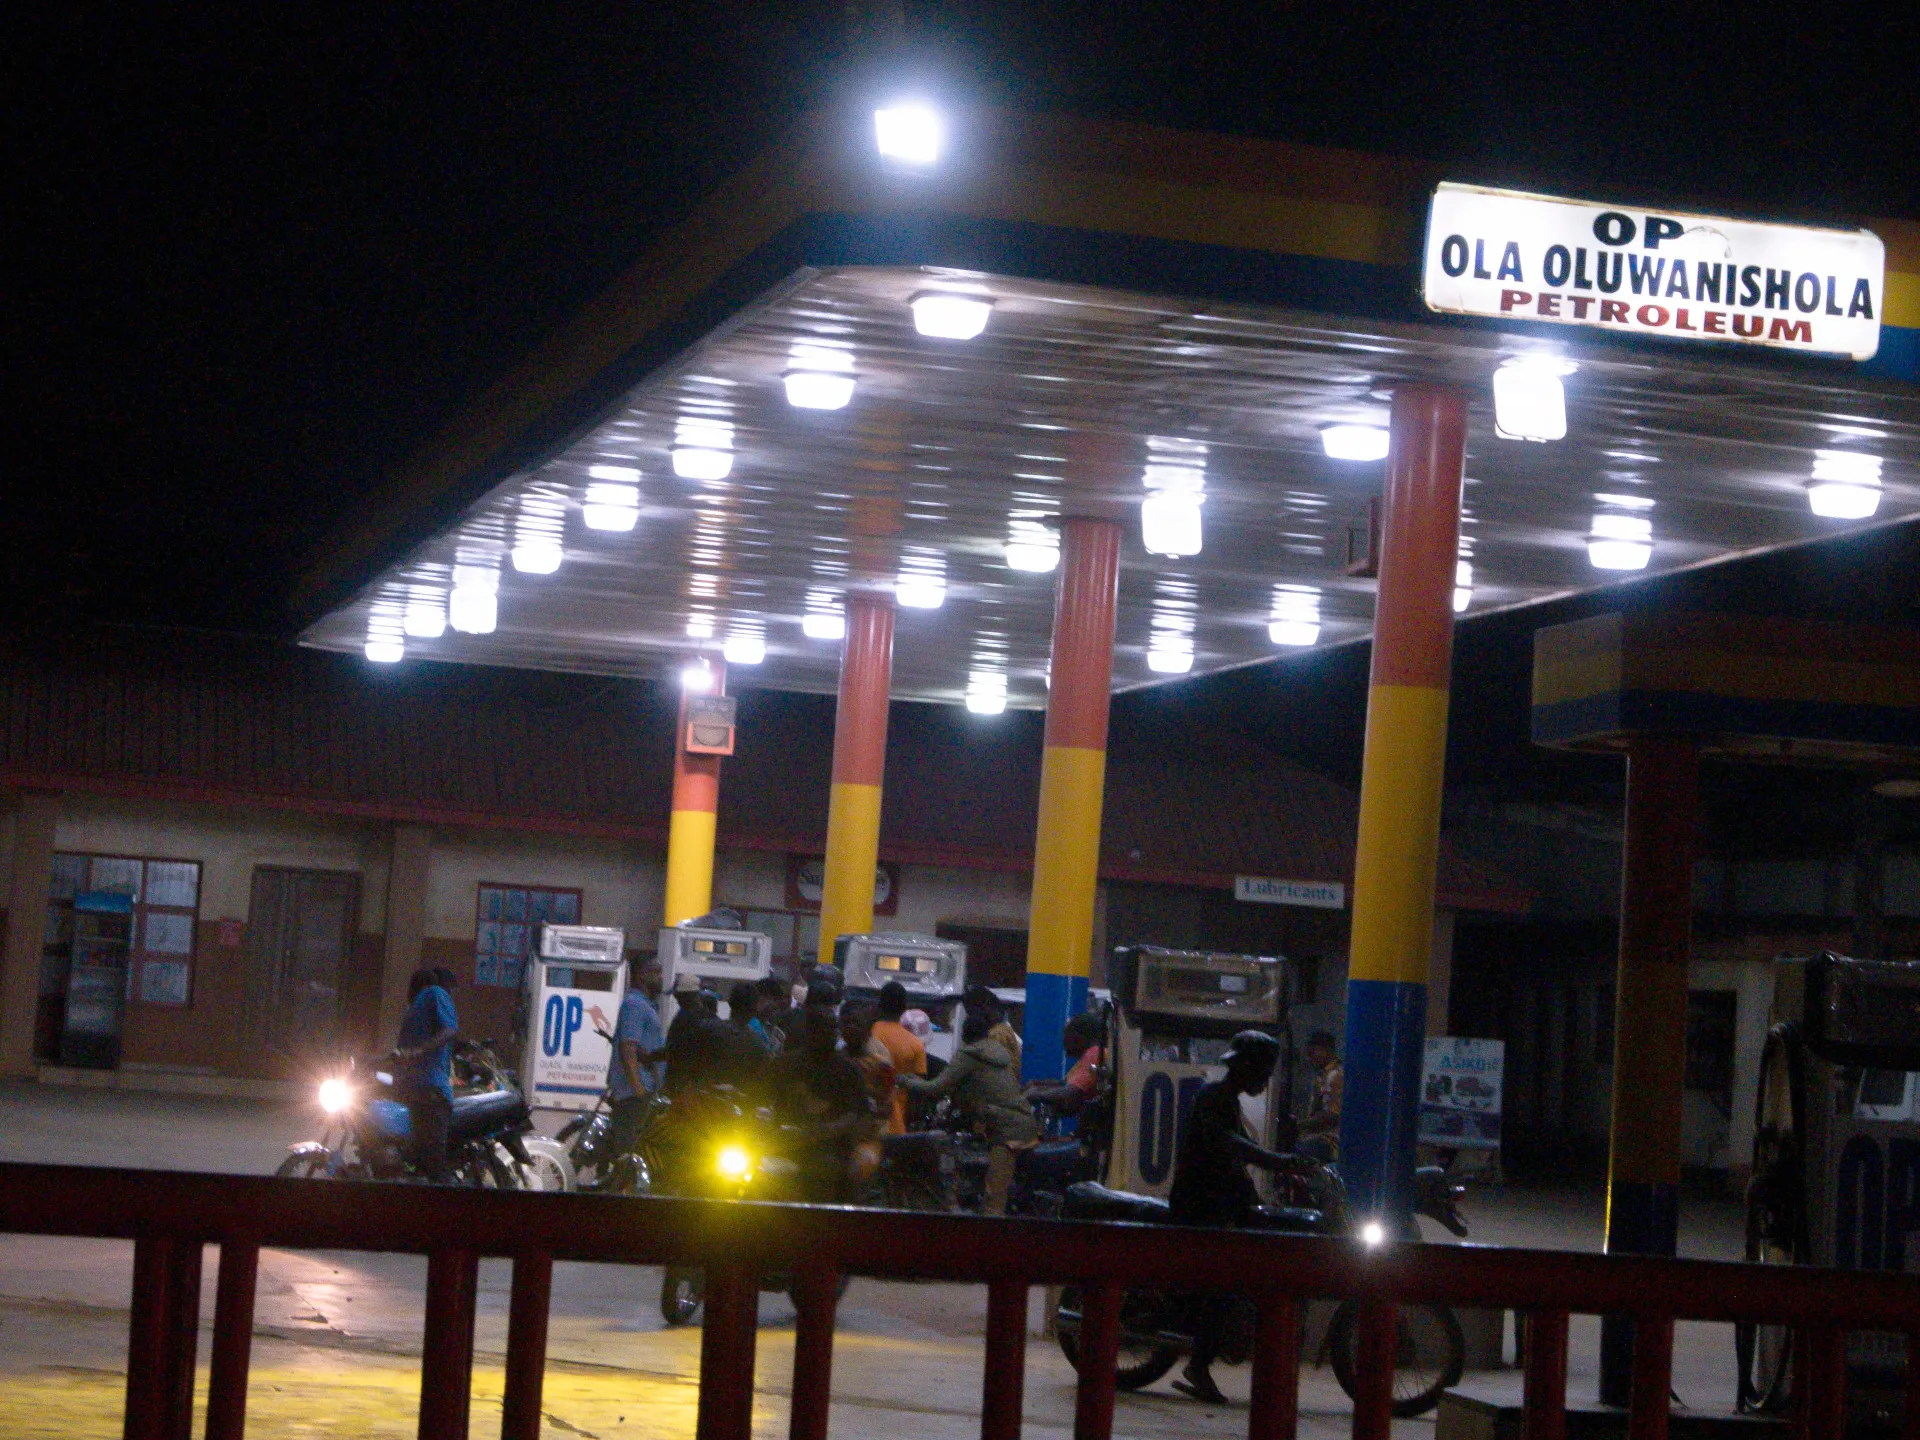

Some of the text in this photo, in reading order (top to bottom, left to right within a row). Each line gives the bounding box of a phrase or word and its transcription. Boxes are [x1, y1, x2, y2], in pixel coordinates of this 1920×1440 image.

[1592, 212, 1684, 250] OP
[1441, 234, 1874, 320] OLA OLUWANISHOLA
[1500, 289, 1812, 344] PETROLEUM
[1243, 880, 1336, 900] Lubricants
[543, 994, 583, 1057] OP
